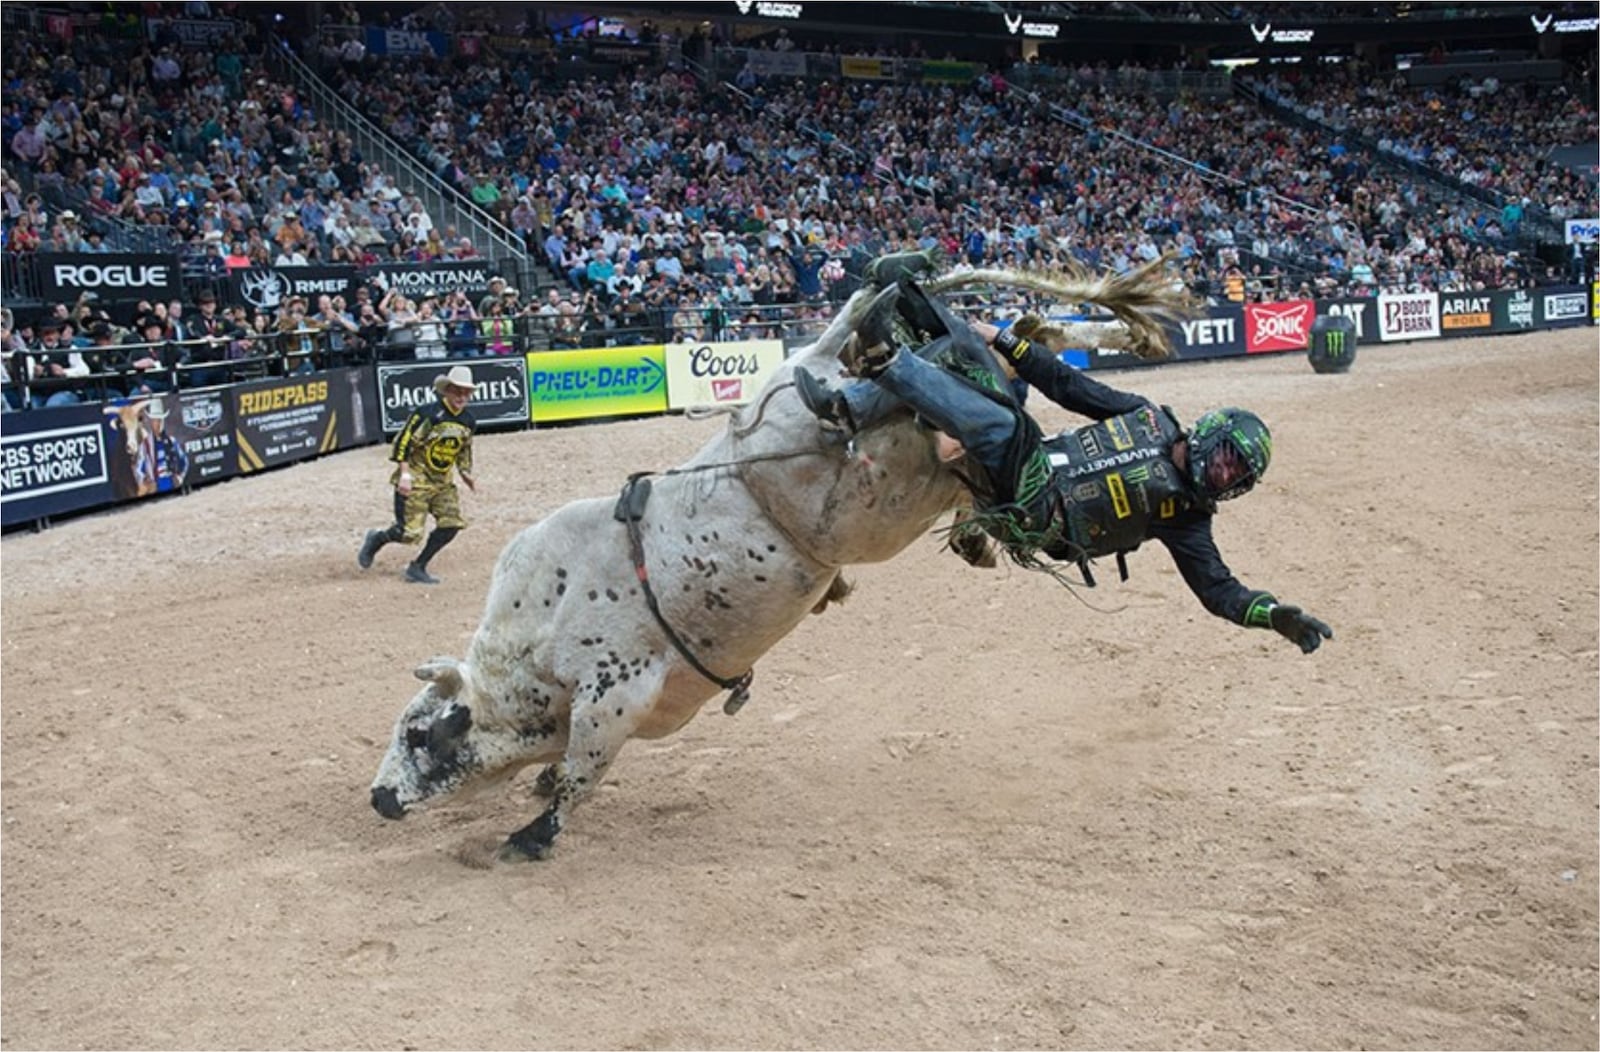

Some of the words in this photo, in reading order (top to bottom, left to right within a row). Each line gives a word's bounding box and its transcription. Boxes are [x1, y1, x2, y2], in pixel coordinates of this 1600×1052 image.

[54, 264, 169, 288] ROGUE
[295, 279, 349, 294] RMEF
[391, 269, 486, 286] MONTANA
[1402, 300, 1431, 315] BOOT
[1443, 297, 1492, 314] ARIAT
[1180, 317, 1235, 346] YETI
[1256, 314, 1304, 337] SONIC
[1404, 316, 1433, 333] BARN
[689, 345, 759, 377] Coors
[532, 366, 652, 393] PNEU-DART
[239, 381, 328, 416] RIDEPASS
[386, 383, 438, 409] JACK
[468, 376, 521, 402] NIEL'S
[33, 435, 98, 463] SPORTS
[1, 457, 85, 490] NETWORK
